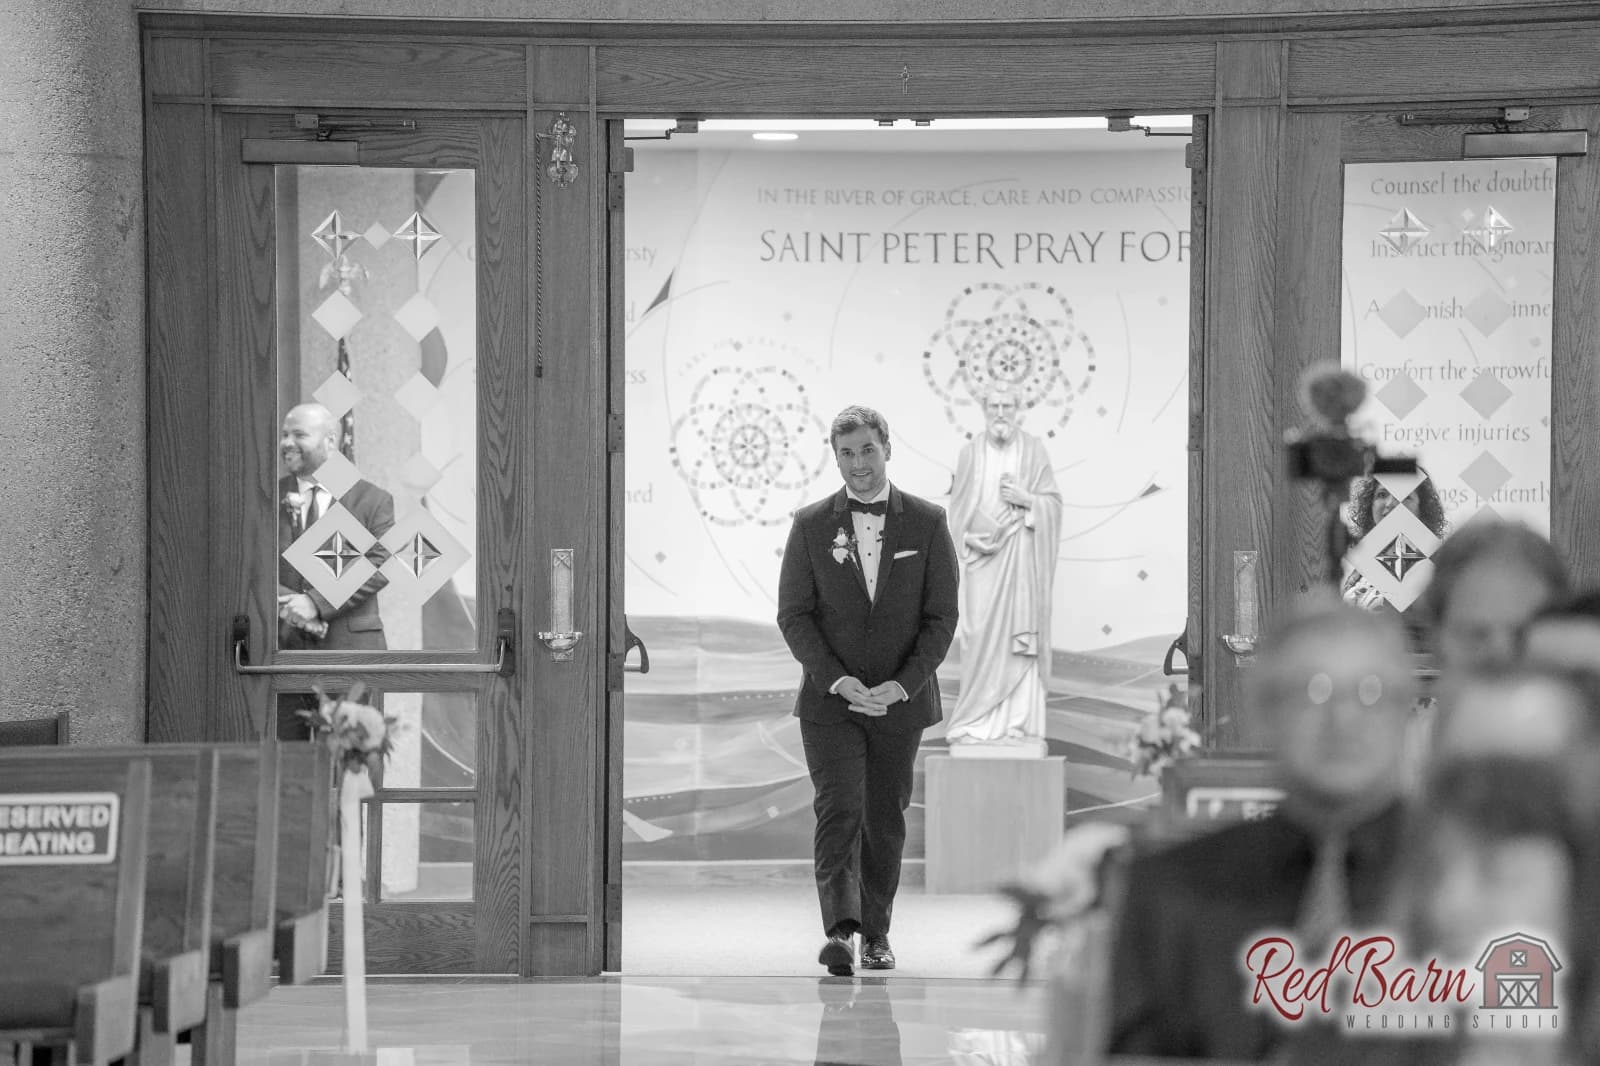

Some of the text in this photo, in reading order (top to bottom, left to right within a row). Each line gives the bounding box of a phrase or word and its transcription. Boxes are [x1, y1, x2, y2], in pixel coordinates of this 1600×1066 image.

[1370, 171, 1445, 195] Counsel
[1453, 173, 1481, 193] the
[757, 187, 779, 205] IN
[783, 187, 817, 205] THE
[824, 188, 876, 206] RIVER
[881, 189, 907, 206] OF
[982, 189, 1031, 206] CARE
[1037, 188, 1082, 205] AND
[759, 229, 872, 263] SAINT
[882, 231, 1005, 269] PETER
[1014, 231, 1105, 264] PRAY
[1440, 358, 1467, 381] the
[1383, 423, 1531, 447] Forgive injuries
[0, 804, 110, 828] ESERVED
[0, 831, 96, 855] EATING
